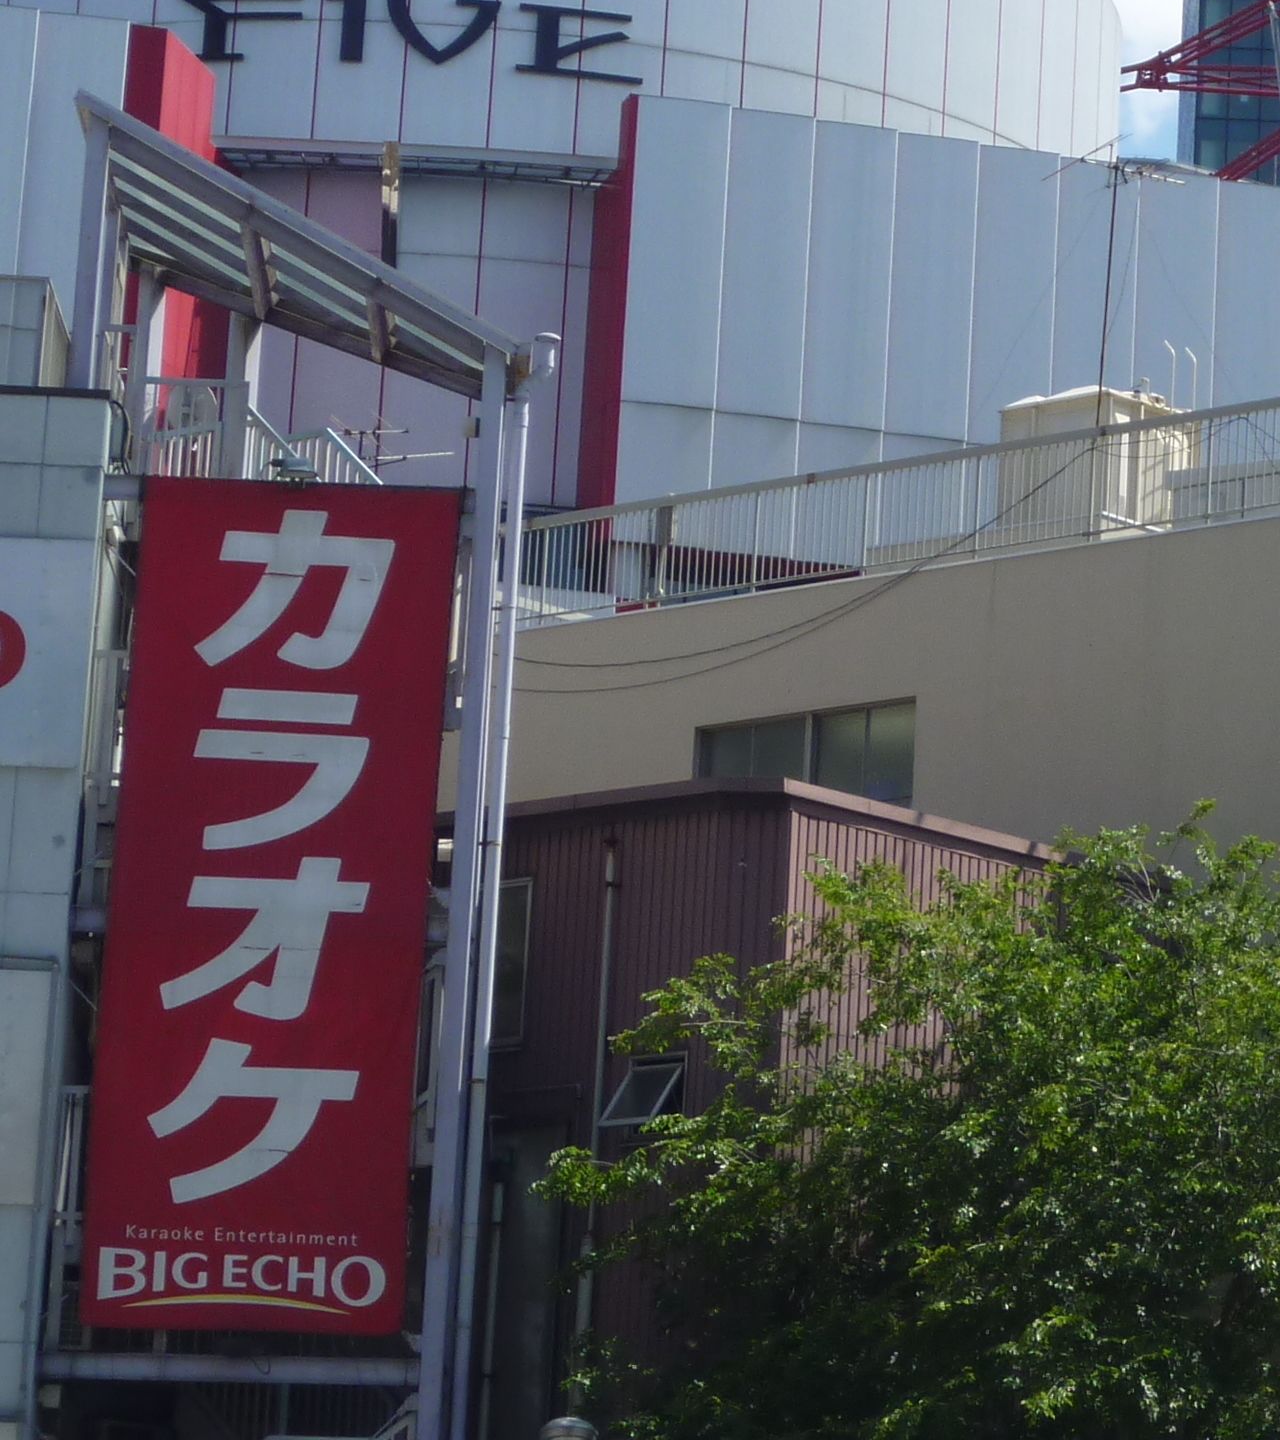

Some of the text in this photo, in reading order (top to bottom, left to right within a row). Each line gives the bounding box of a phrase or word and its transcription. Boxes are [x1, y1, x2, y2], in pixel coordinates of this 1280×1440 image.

[147, 509, 395, 1204] カラオケ
[126, 1224, 358, 1246] Karaoke Entertainment
[97, 1246, 386, 1307] BIG ECHO
